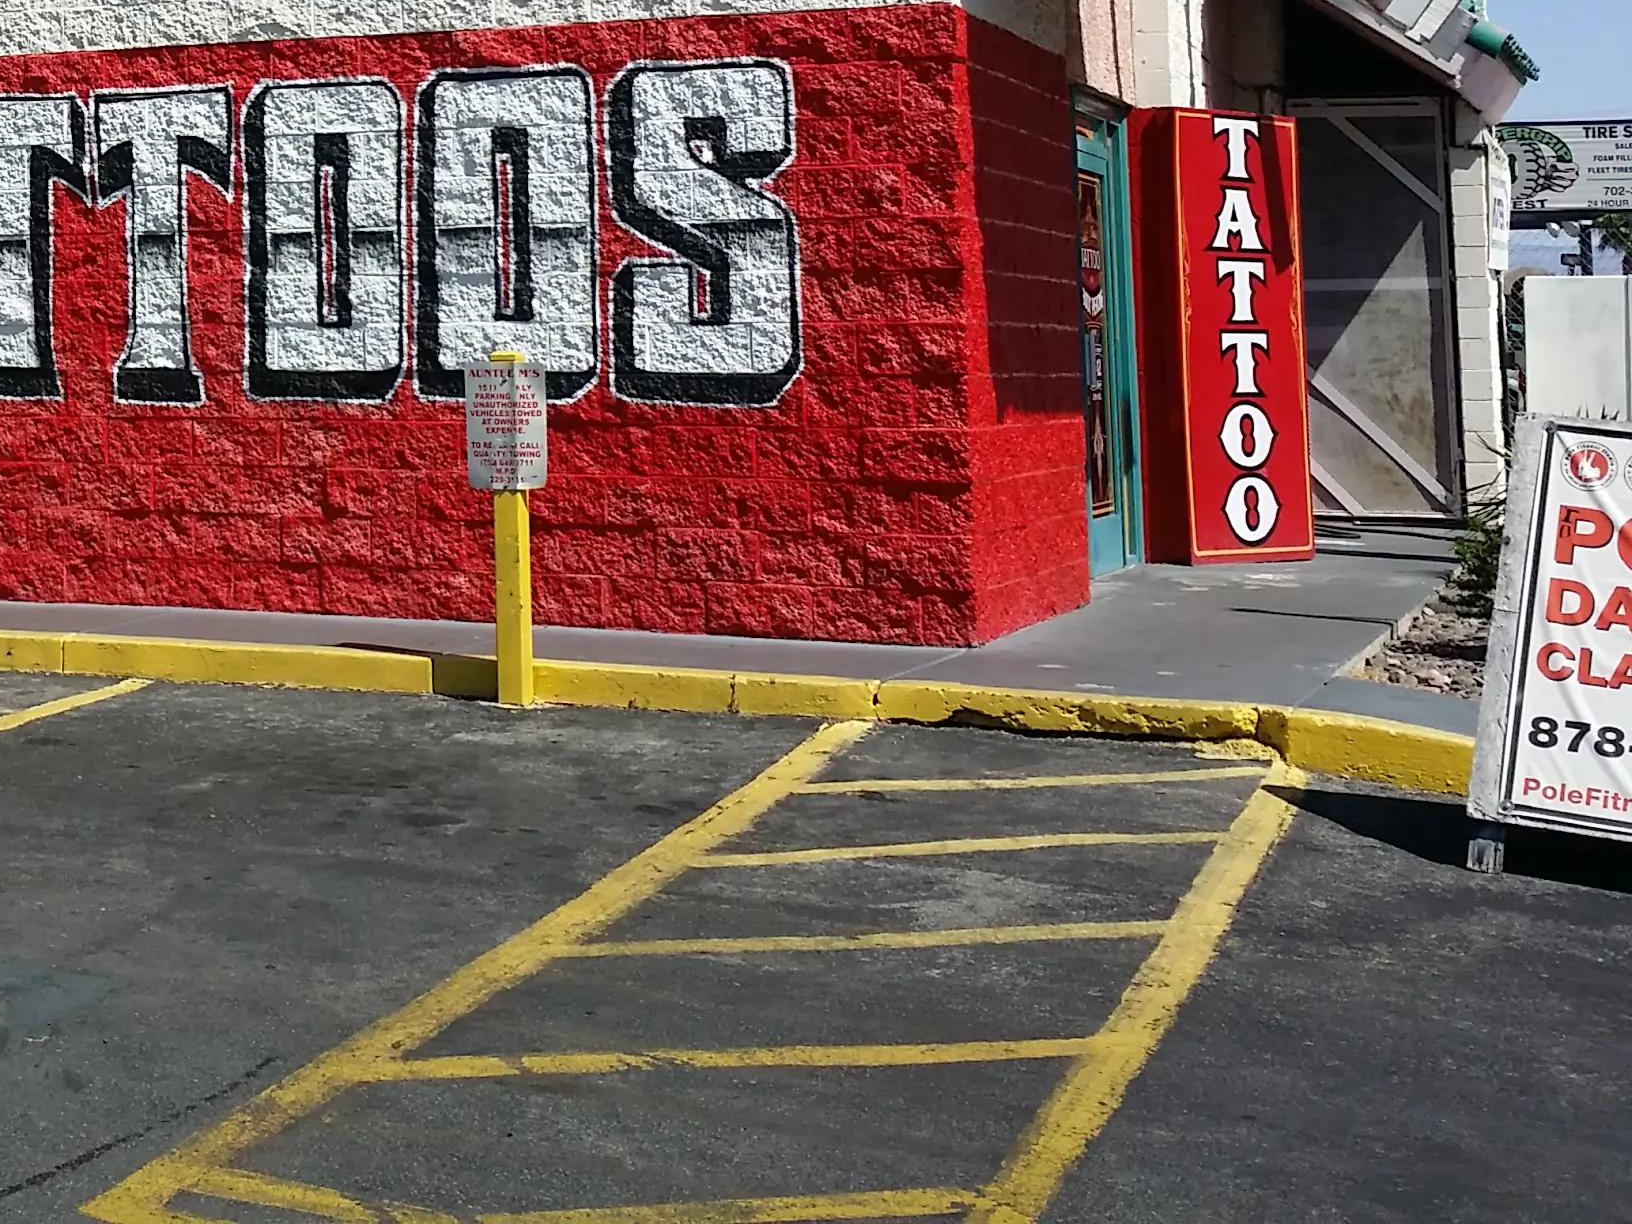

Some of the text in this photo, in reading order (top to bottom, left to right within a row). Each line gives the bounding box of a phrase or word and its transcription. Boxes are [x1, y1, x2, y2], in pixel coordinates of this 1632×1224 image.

[1582, 126, 1618, 138] TIRE
[1616, 154, 1632, 162] FILL
[1512, 199, 1548, 210] EST
[1601, 199, 1629, 207] HOUR
[1210, 116, 1280, 545] TATTOO
[474, 392, 536, 400] PARKING NLY
[473, 401, 539, 409] UNAUTHORIZED
[494, 418, 530, 426] OWNERS
[471, 441, 481, 449] TO
[473, 450, 541, 458] QUATY TOWING
[1554, 504, 1632, 566] P
[1545, 577, 1632, 632] DA
[1536, 642, 1632, 689] CLA
